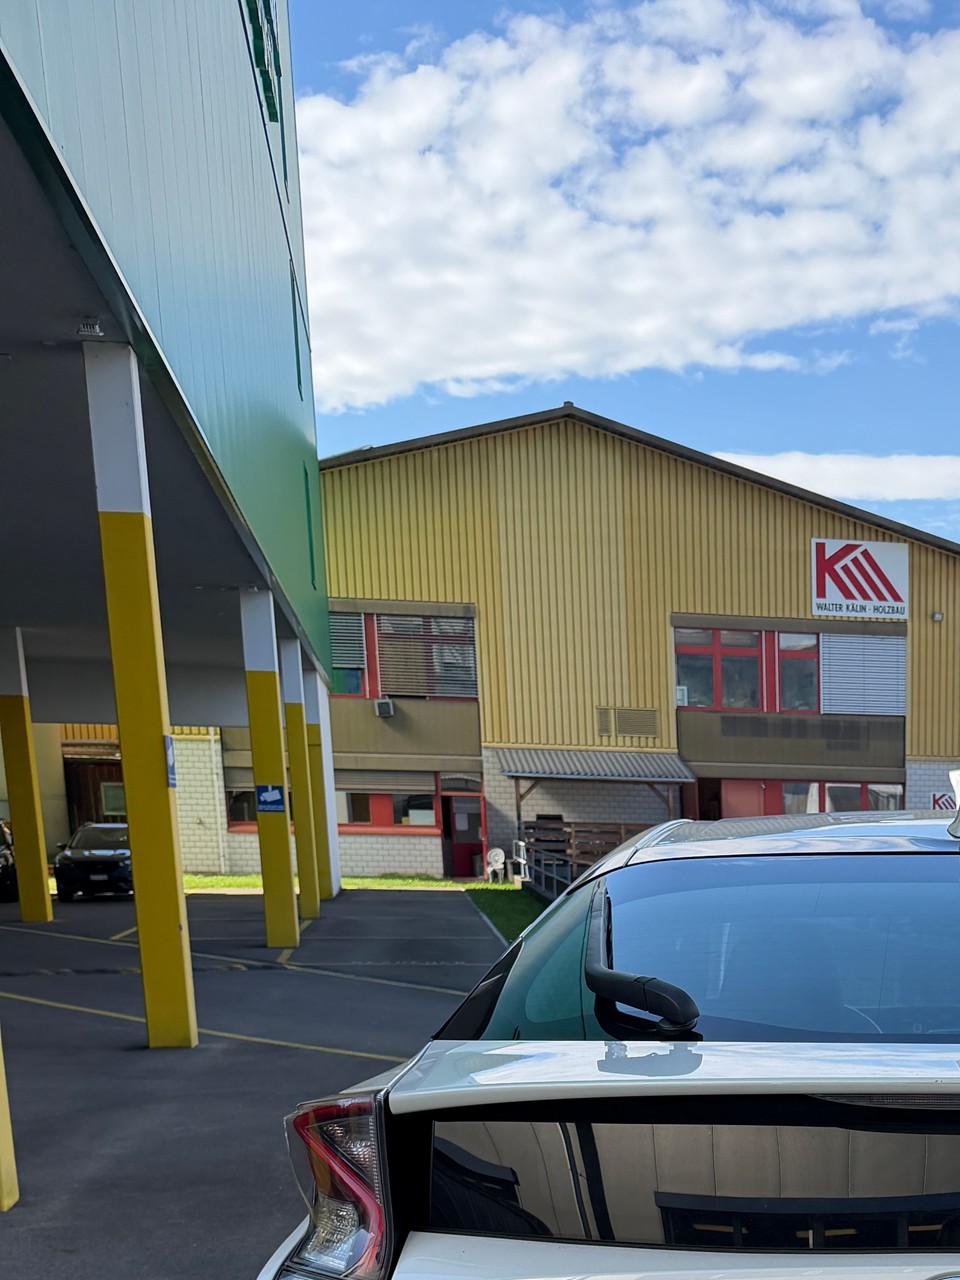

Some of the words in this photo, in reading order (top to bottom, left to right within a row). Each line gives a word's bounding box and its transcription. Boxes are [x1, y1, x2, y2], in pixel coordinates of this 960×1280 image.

[816, 602, 843, 613] WALTER
[846, 602, 867, 614] KÄLIN
[873, 605, 906, 615] HOLZBAU
